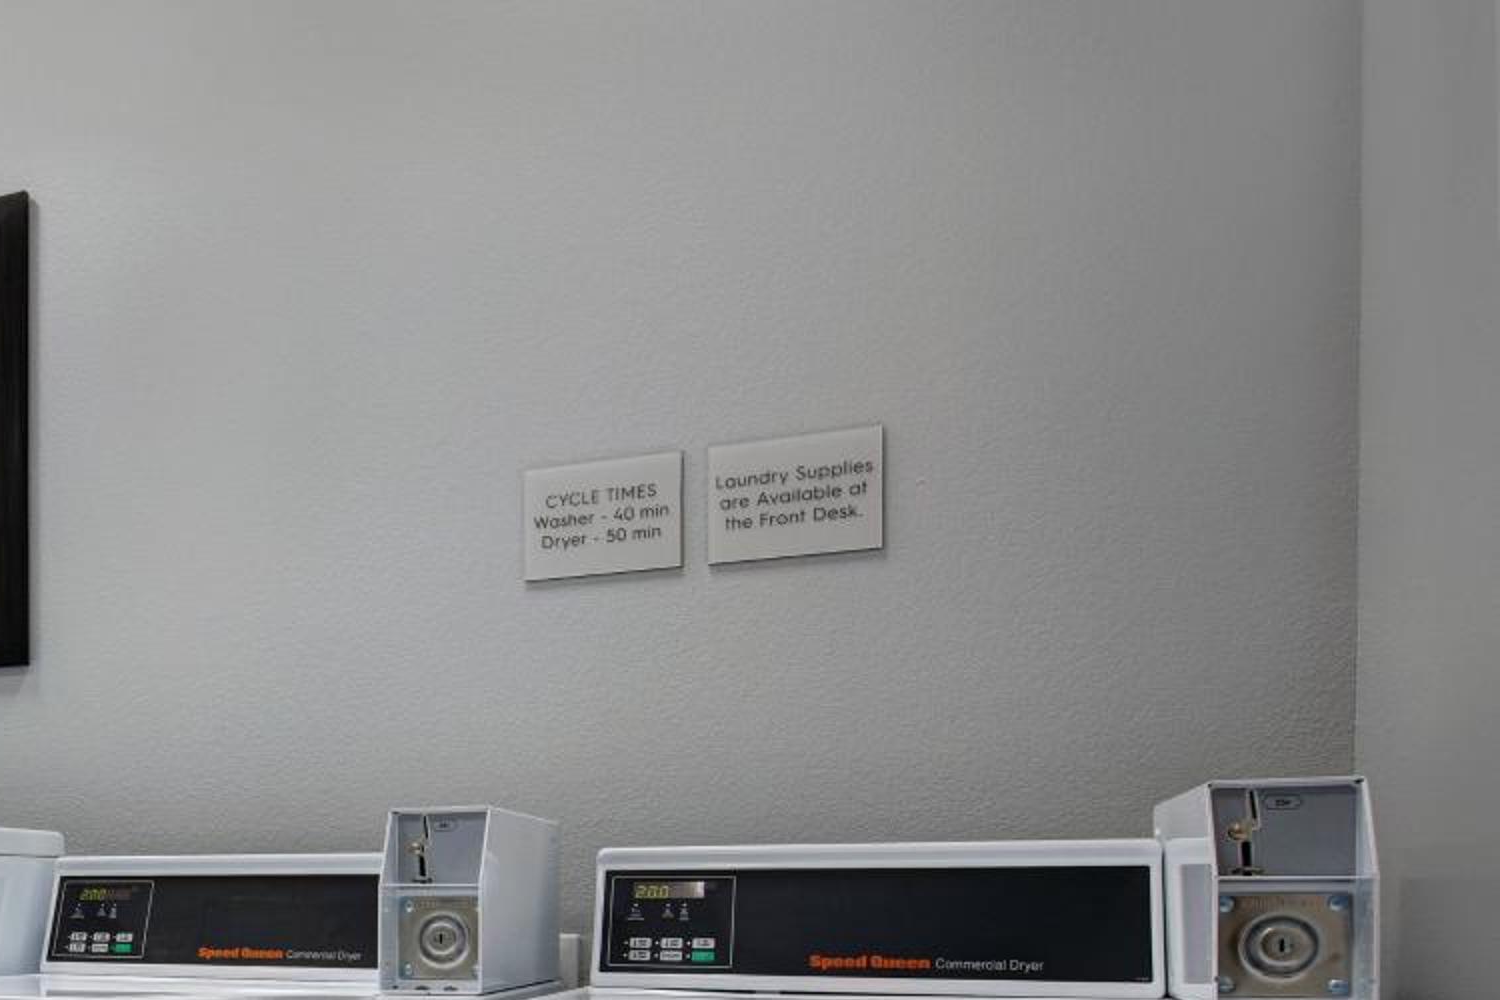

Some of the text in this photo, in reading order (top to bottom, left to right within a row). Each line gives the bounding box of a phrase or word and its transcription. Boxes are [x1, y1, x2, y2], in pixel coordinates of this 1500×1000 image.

[715, 460, 873, 489] Laundry Supplies
[545, 483, 657, 508] CYCLE TIMES
[719, 482, 867, 510] are Available at
[533, 513, 594, 529] Washer
[613, 506, 635, 521] 40
[639, 504, 670, 519] min
[725, 505, 864, 530] the Front Desk.
[541, 535, 586, 550] Dryer
[606, 527, 627, 543] 50
[632, 527, 661, 540] min
[197, 946, 239, 960] Speed
[241, 947, 284, 959] Queen
[809, 954, 1044, 973] Speed Queen Commercial Dryer
